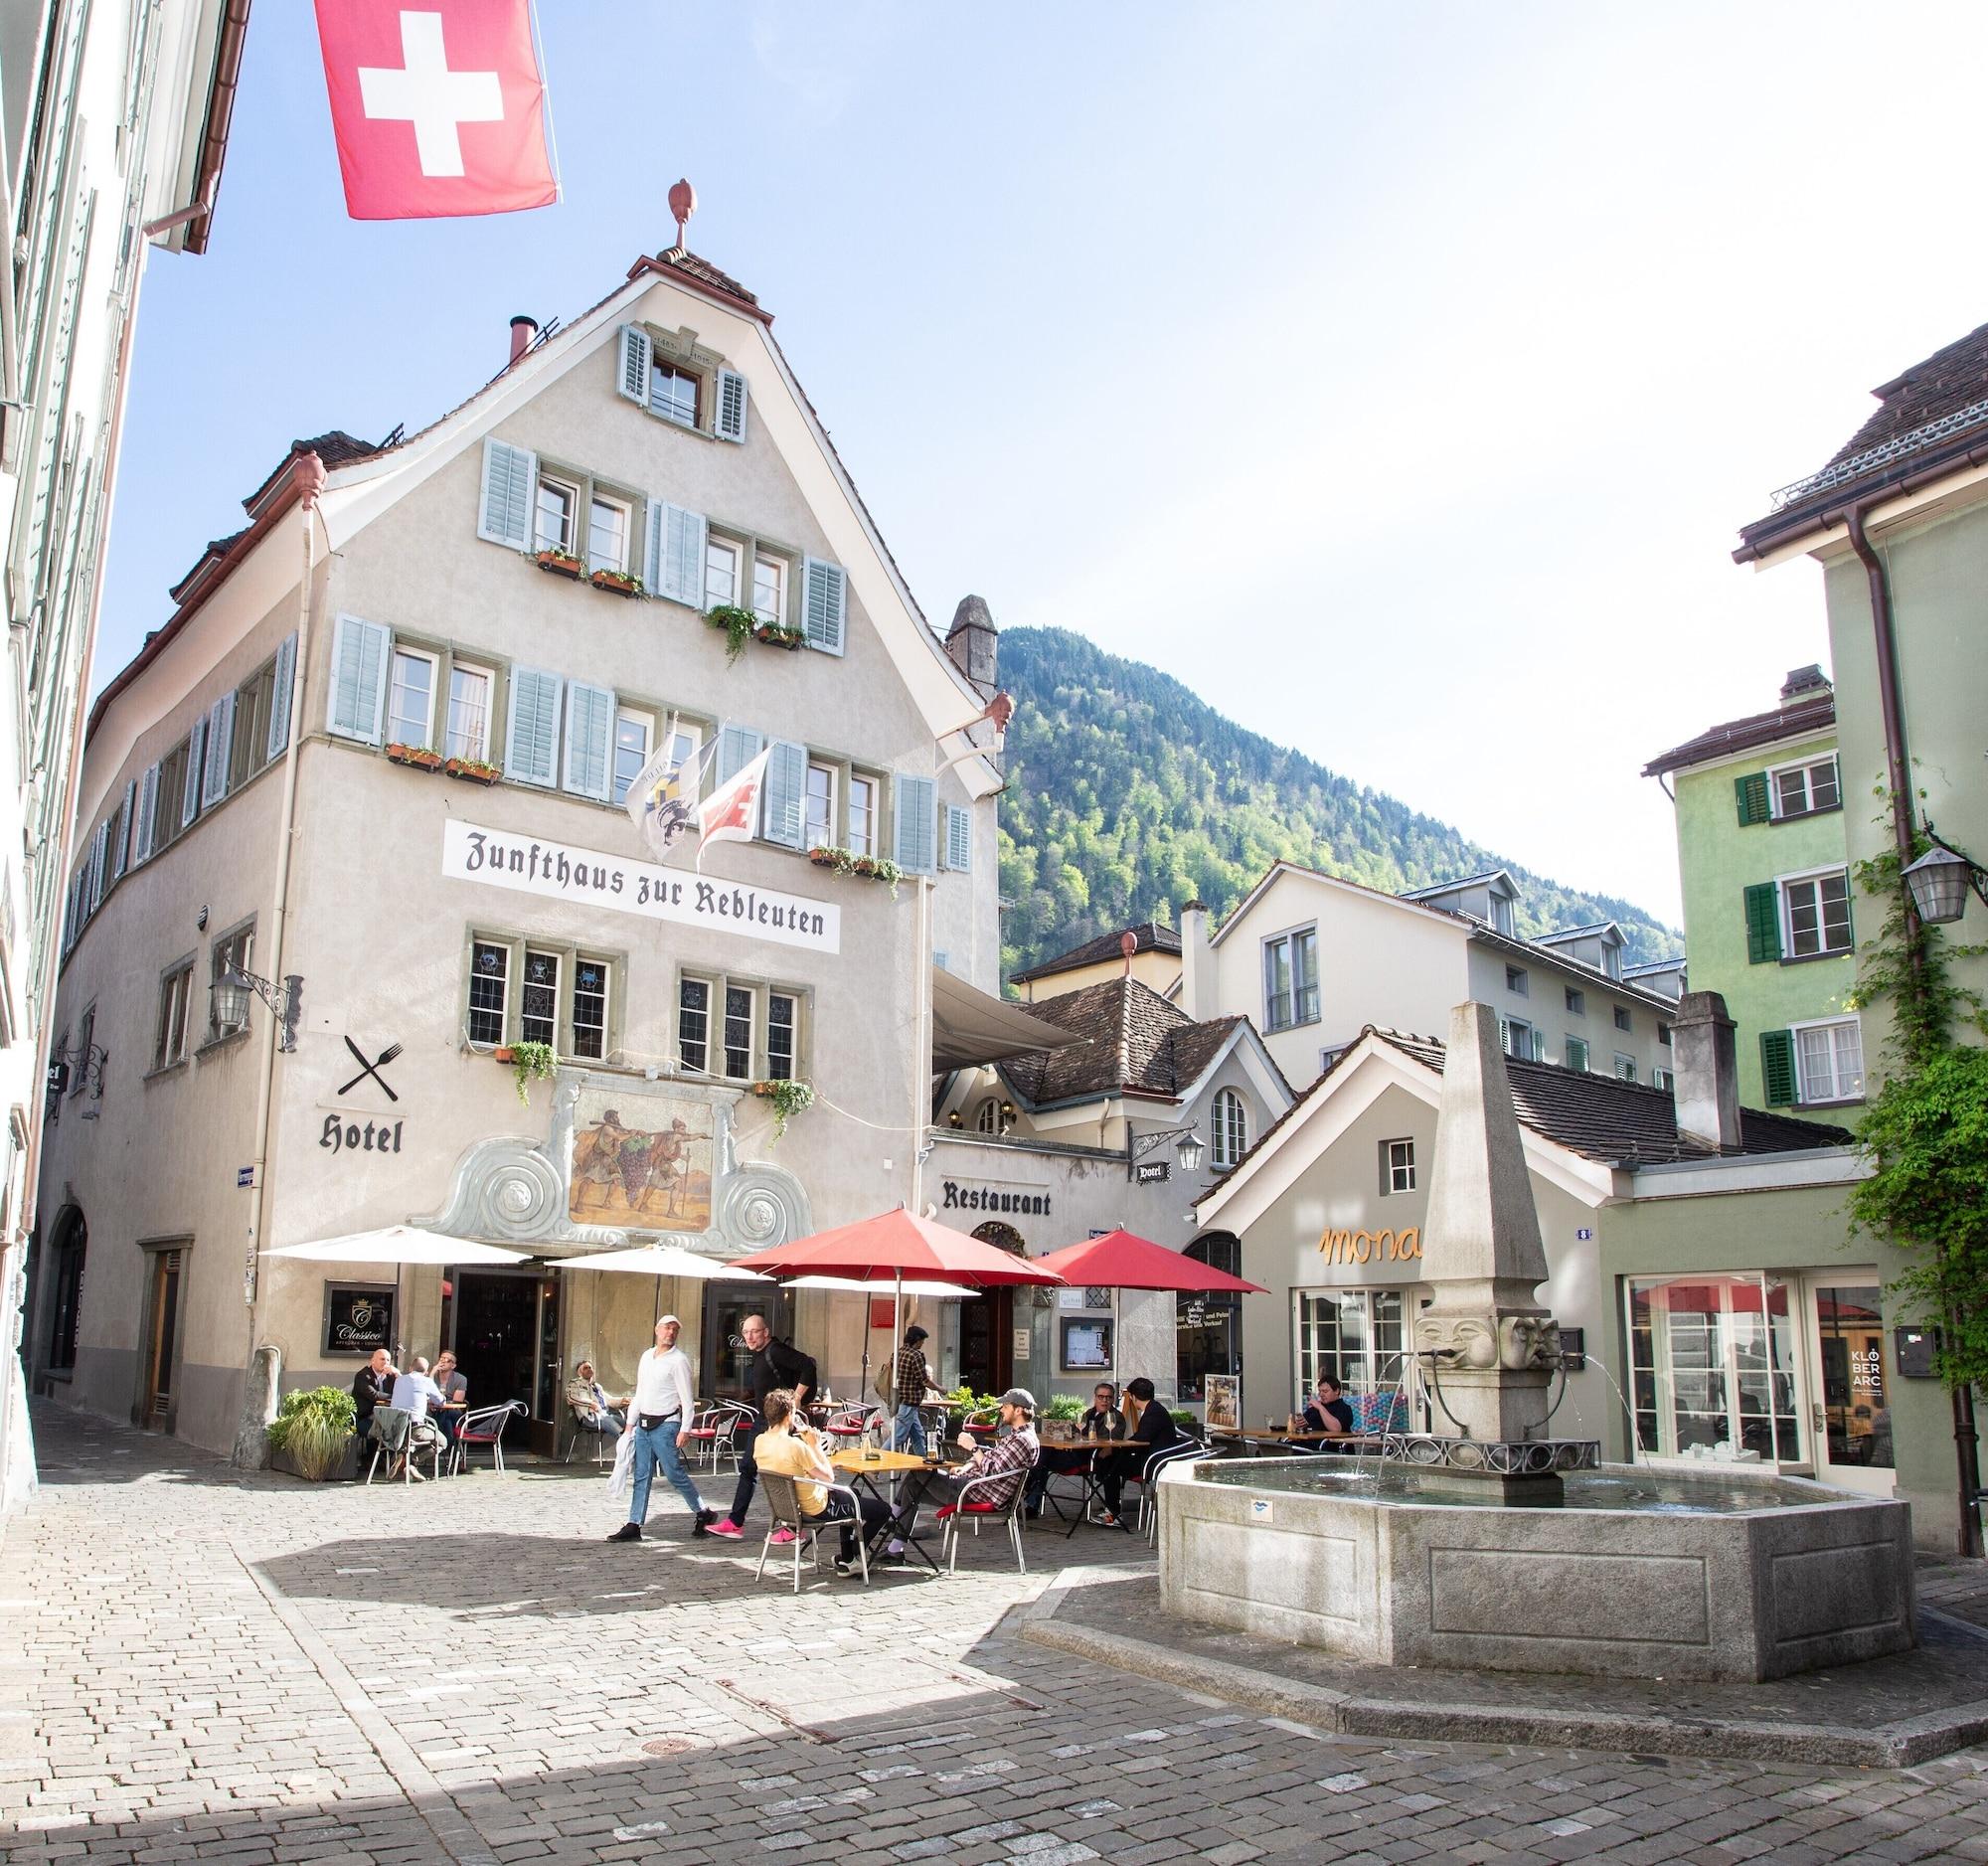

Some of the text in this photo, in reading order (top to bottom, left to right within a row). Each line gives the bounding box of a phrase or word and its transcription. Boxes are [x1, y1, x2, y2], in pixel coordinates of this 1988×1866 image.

[465, 831, 825, 937] Zunfthaus zur Rebleuten
[319, 1113, 404, 1155] Hotel
[1139, 1164, 1161, 1178] Hotel
[943, 1181, 1051, 1216] Restaurant
[1580, 1230, 1586, 1239] 8
[1319, 1225, 1423, 1266] mona
[336, 1323, 381, 1341] Classico
[1852, 1363, 1881, 1374] BER
[1853, 1375, 1882, 1386] ARC
